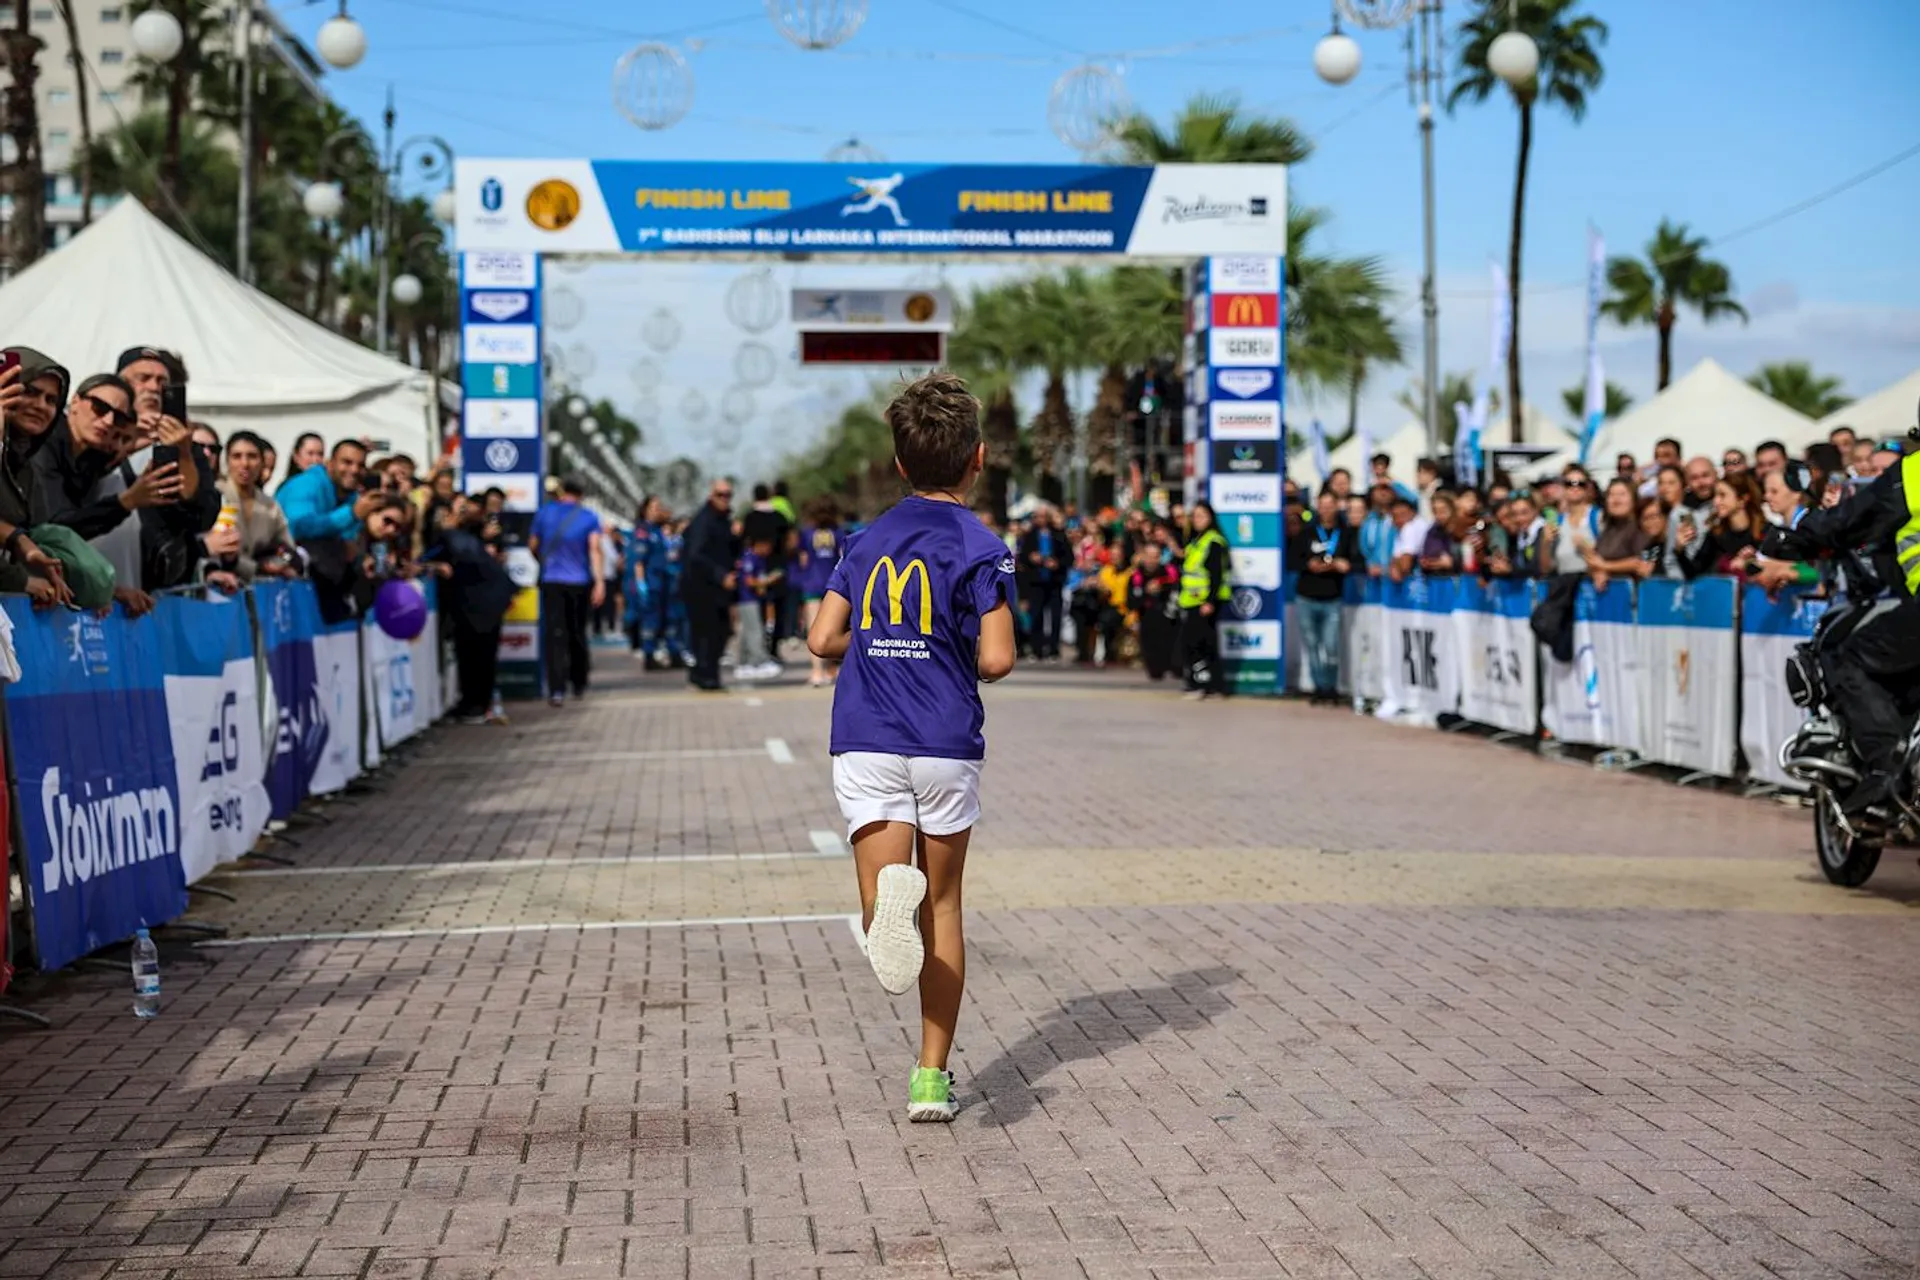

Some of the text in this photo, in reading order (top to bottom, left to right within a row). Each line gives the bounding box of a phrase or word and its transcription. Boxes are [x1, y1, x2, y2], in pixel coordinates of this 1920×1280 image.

[635, 189, 791, 209] FINISH LINE
[958, 191, 1113, 212] FINISH LINE
[877, 229, 1012, 245] INTERNATIONAL
[1014, 230, 1114, 245] MARATHON
[867, 648, 889, 657] KIDS
[890, 649, 911, 658] RACE
[41, 766, 176, 894] Stoiximan
